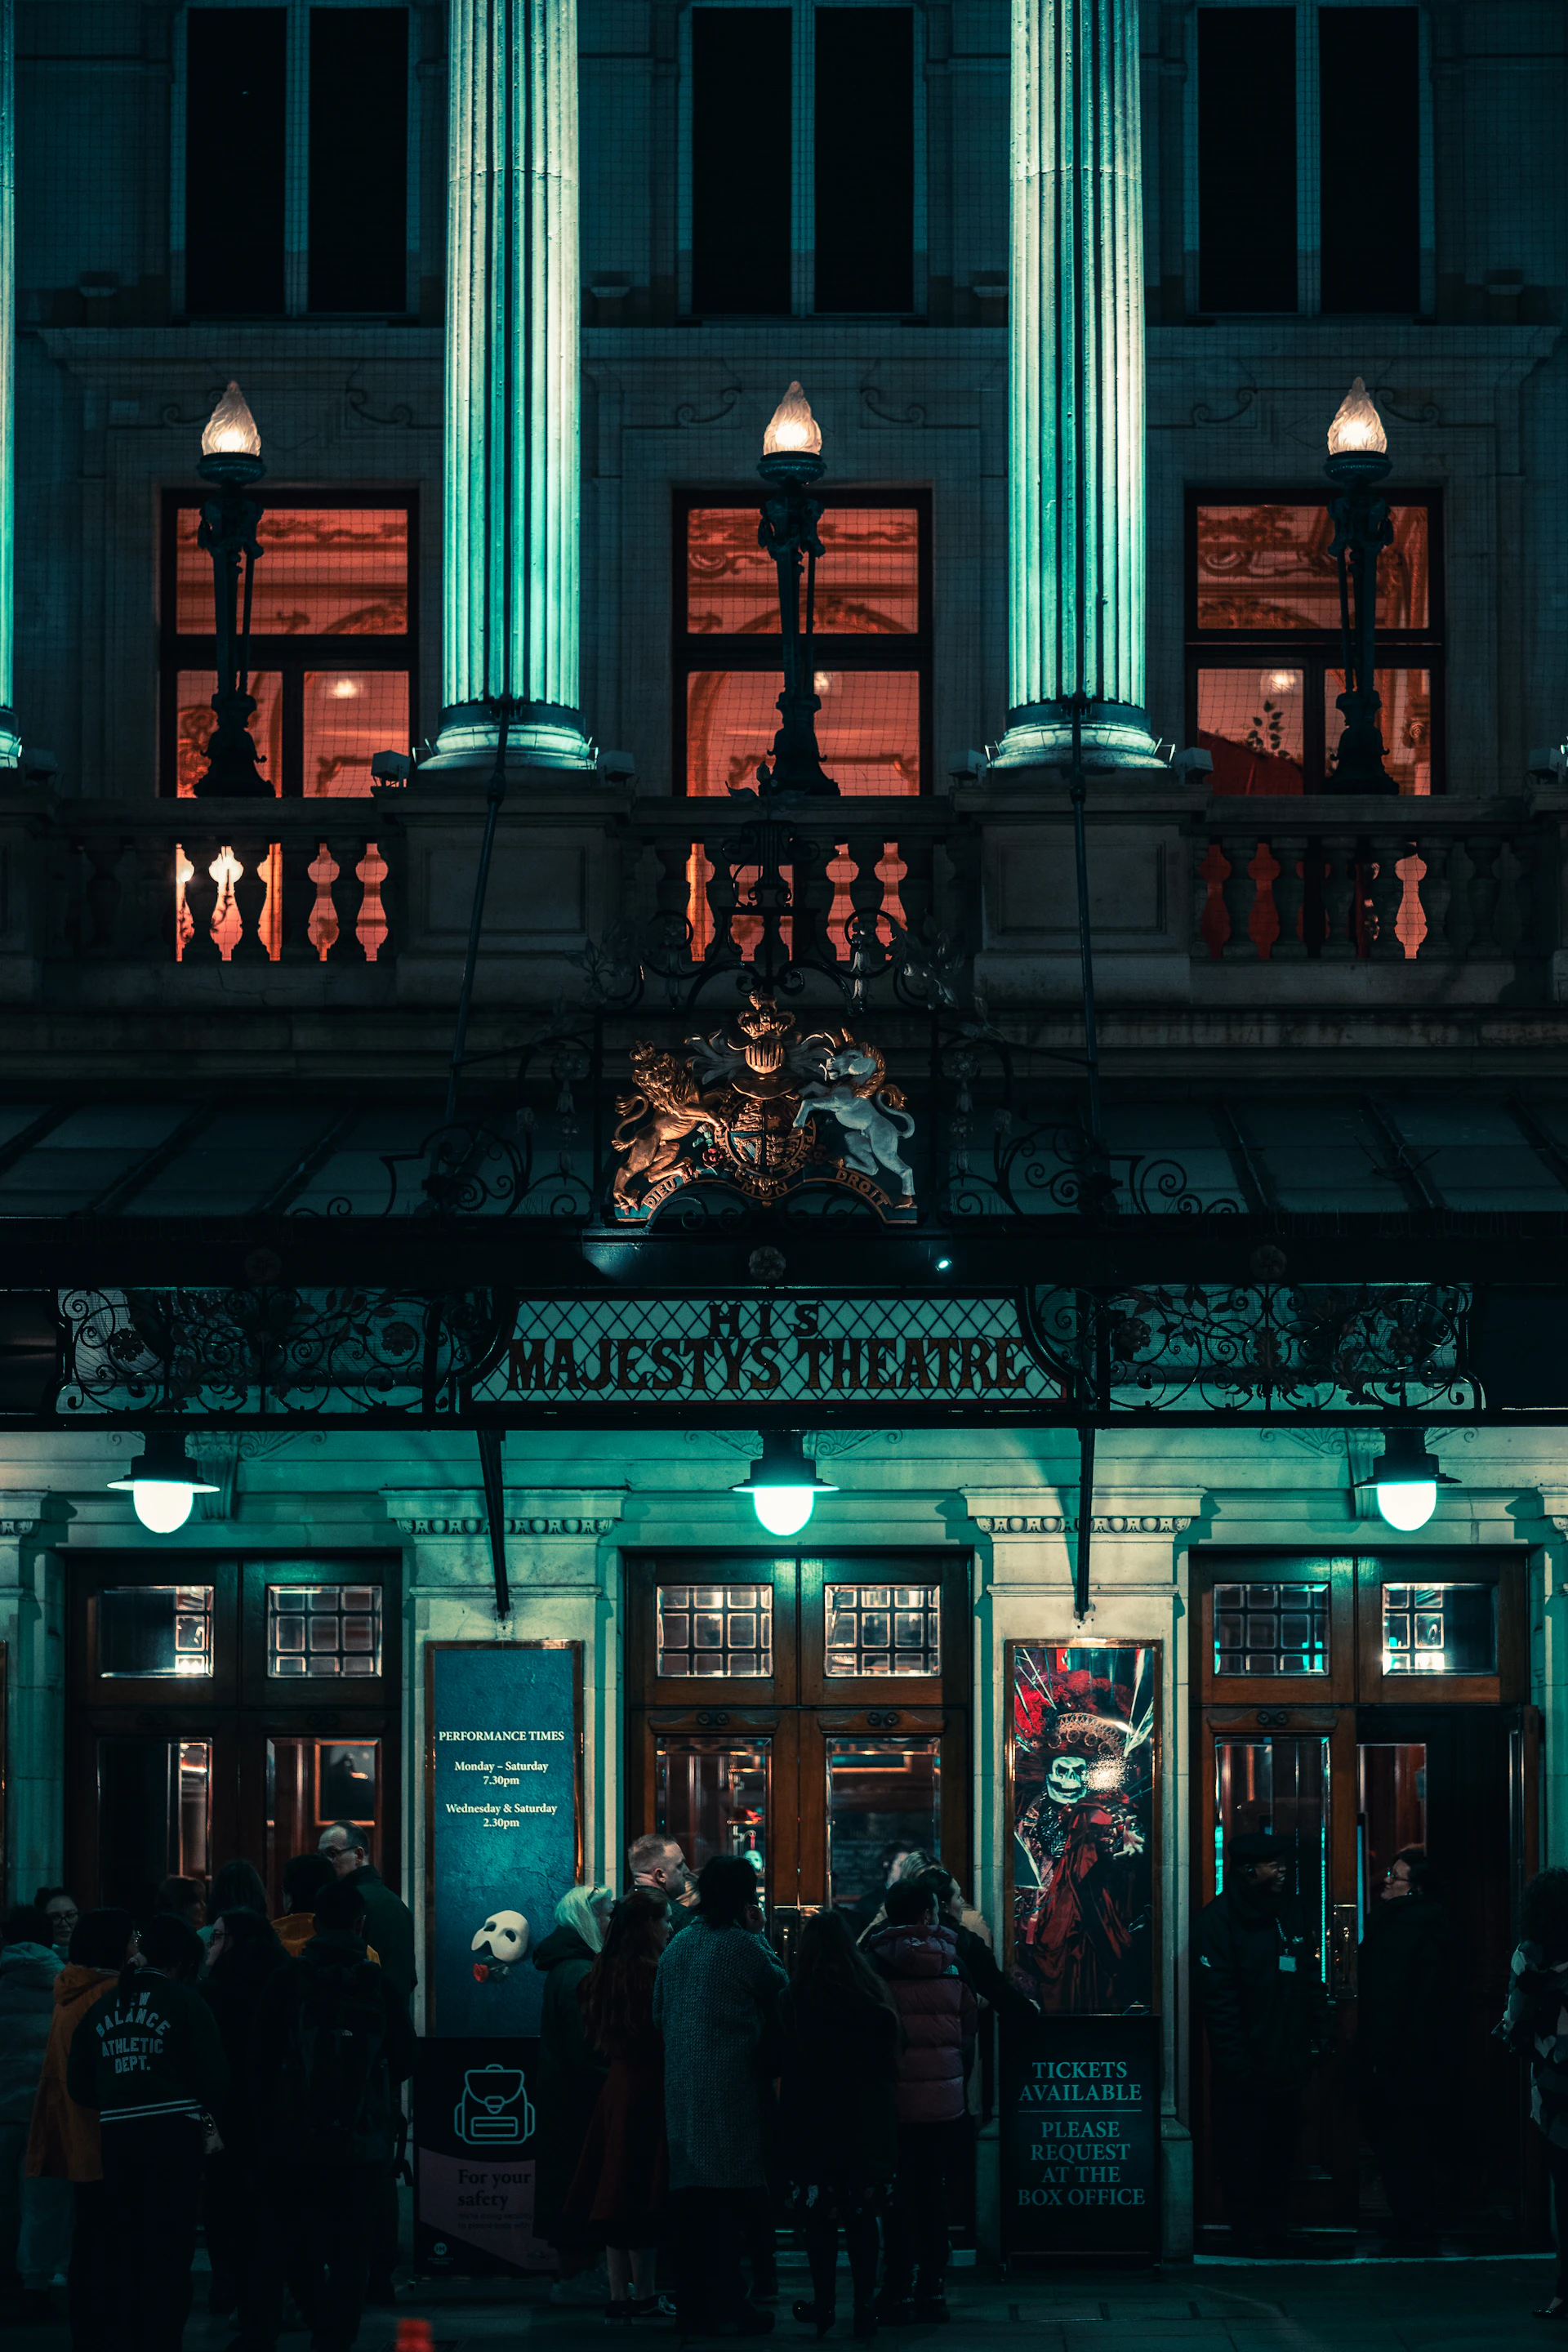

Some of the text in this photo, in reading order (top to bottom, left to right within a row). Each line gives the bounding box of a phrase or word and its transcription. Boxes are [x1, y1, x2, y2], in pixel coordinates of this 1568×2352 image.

[644, 1178, 677, 1209] DIEU
[742, 1182, 789, 1197] MON
[835, 1169, 889, 1206] DROIT
[709, 1303, 820, 1339] HIS
[796, 1337, 1035, 1390] THEATRE
[439, 1731, 565, 1741] PERFORMANCE TIMES
[454, 1761, 495, 1773] Monday
[505, 1761, 549, 1773] Saturday
[483, 1775, 520, 1787] 7.30pm
[446, 1802, 558, 1815] Wednesday & Saturday
[483, 1818, 520, 1829] 2.30pm
[96, 2007, 172, 2038] BALANCE
[101, 2037, 164, 2057] ATHLETIC
[114, 2055, 152, 2074] DEPT.
[1031, 2061, 1128, 2078] TICKETS
[1018, 2083, 1143, 2101] AVAILABLE
[1040, 2121, 1120, 2138] PLEASE
[1030, 2143, 1131, 2164] REQUEST
[457, 2168, 532, 2189] For your
[1040, 2166, 1121, 2183] AT THE
[457, 2189, 509, 2211] safety
[1017, 2188, 1146, 2206] BOX OFFICE
